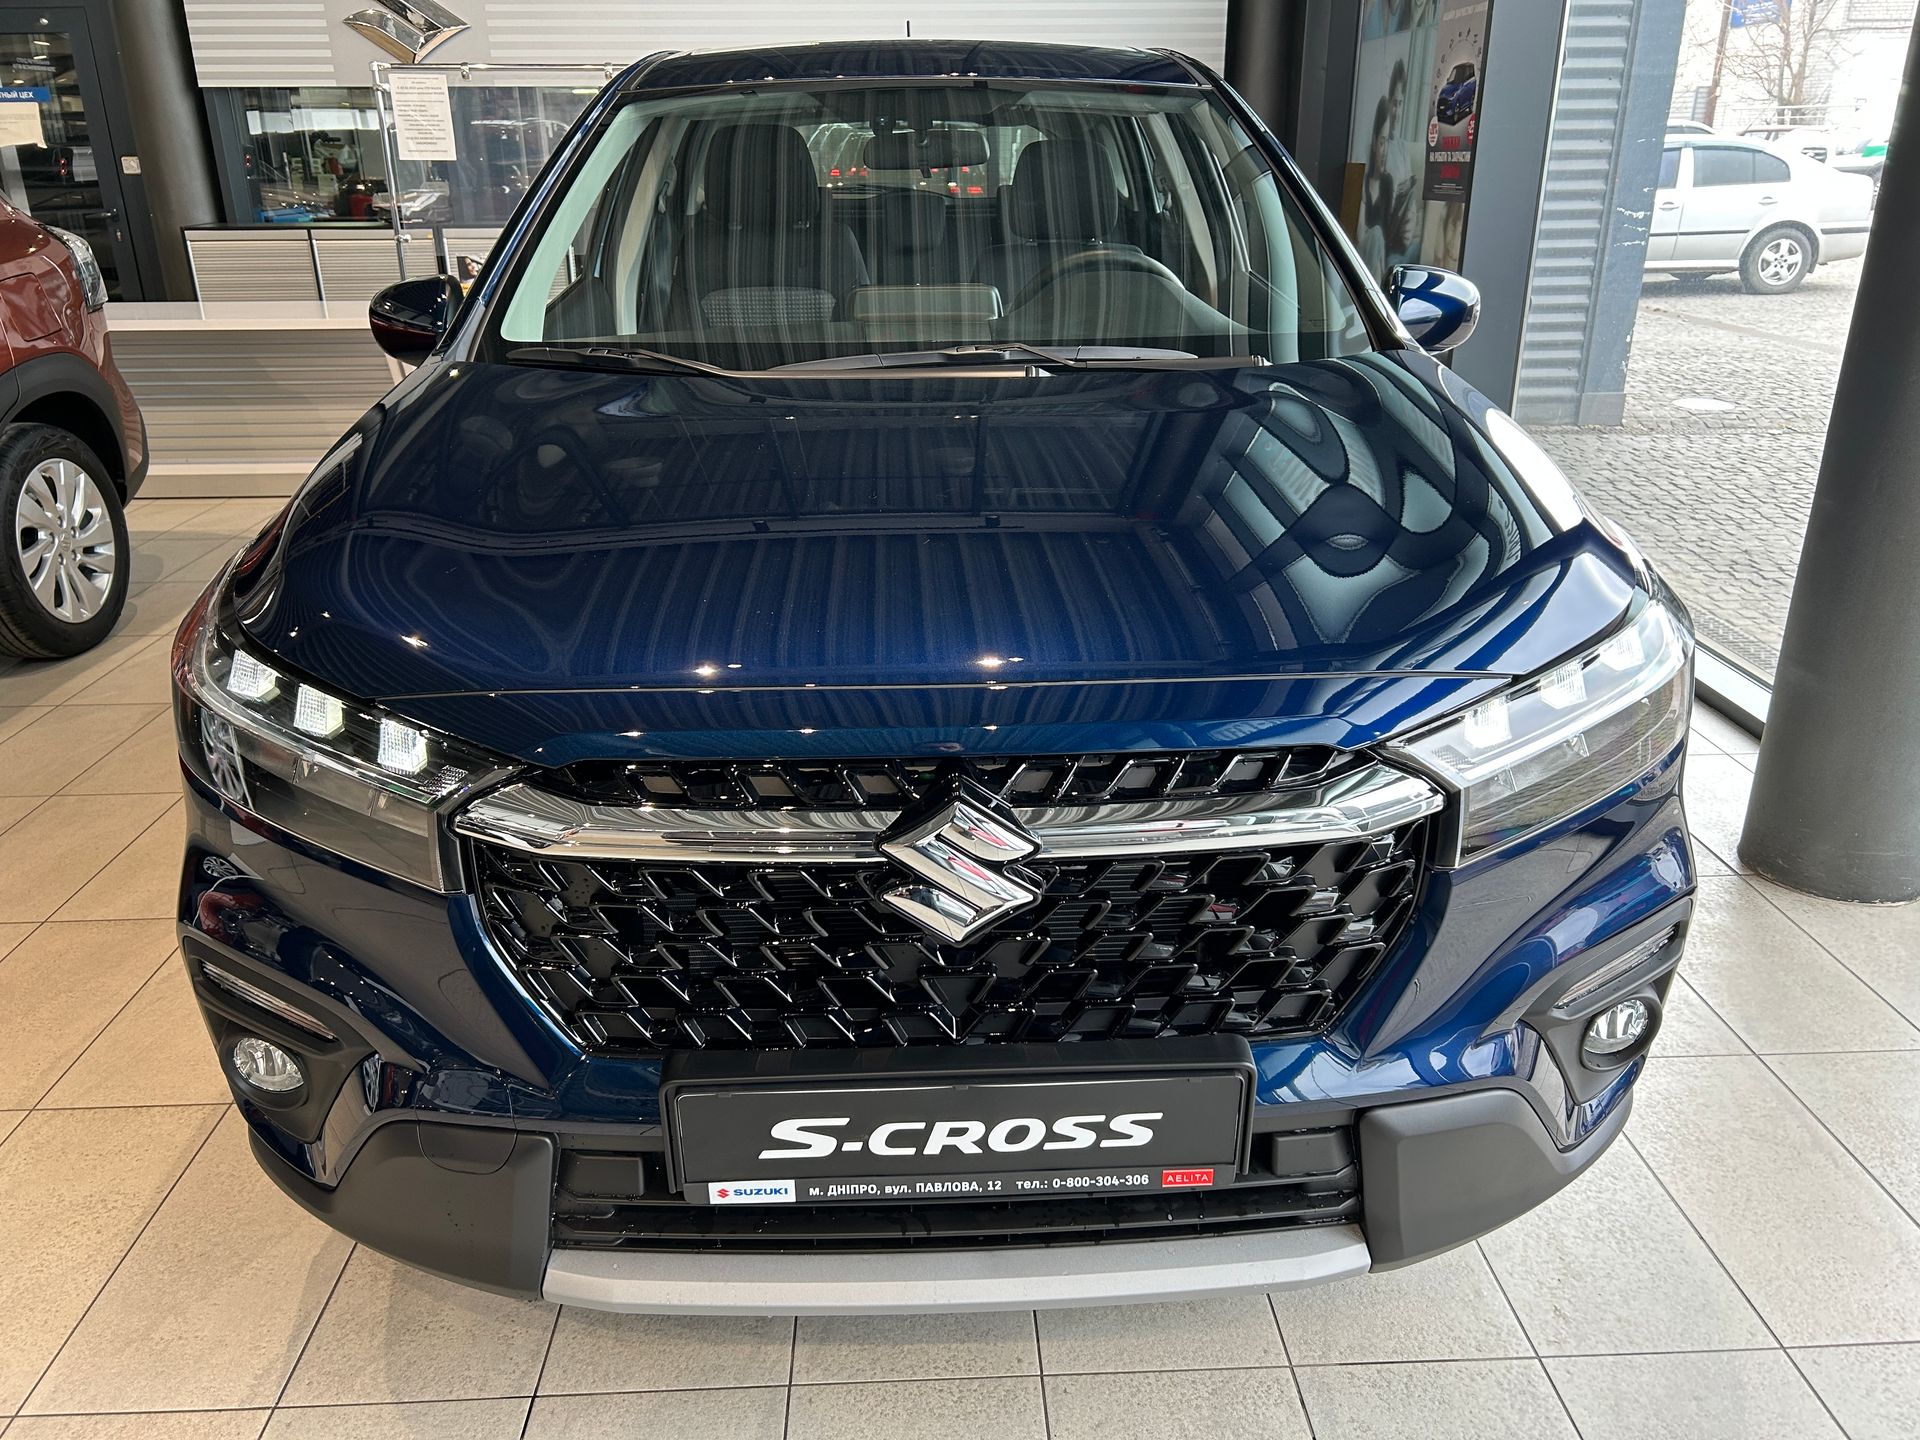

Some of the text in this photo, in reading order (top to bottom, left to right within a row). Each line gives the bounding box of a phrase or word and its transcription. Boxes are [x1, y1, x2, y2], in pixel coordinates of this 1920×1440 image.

[19, 91, 34, 99] ЦЕХ
[758, 1112, 1164, 1160] S-CROSS
[1166, 1173, 1209, 1183] AELITA
[809, 1174, 1149, 1197] м. ДНІПРО, вул. ПАВЛОВА, 12 тел.: 0-800-304-306
[733, 1187, 788, 1196] SUZUKI
